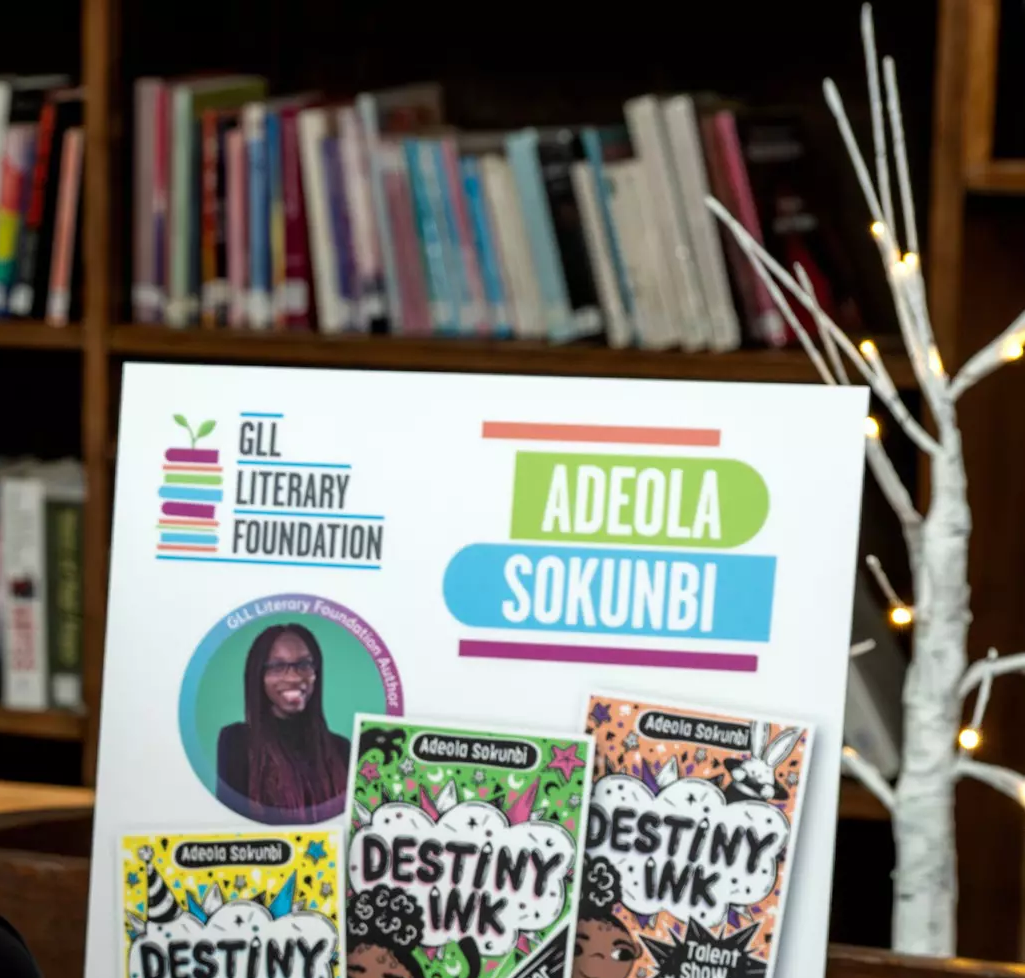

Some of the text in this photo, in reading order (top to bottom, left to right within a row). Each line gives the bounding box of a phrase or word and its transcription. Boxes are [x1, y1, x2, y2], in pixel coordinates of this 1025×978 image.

[239, 420, 282, 458] GLL
[235, 469, 351, 510] LITERARY
[540, 463, 723, 541] ADEOLA
[231, 518, 384, 561] FOUNDATION
[501, 552, 718, 633] SOKUNBI
[226, 599, 399, 709] GLL Literary Foundation Author
[419, 736, 528, 764] Adeola Sokunbi
[644, 714, 750, 747] Adeola Sokunbi
[181, 843, 284, 862] Adeola Sokunbi
[686, 940, 741, 968] Talent
